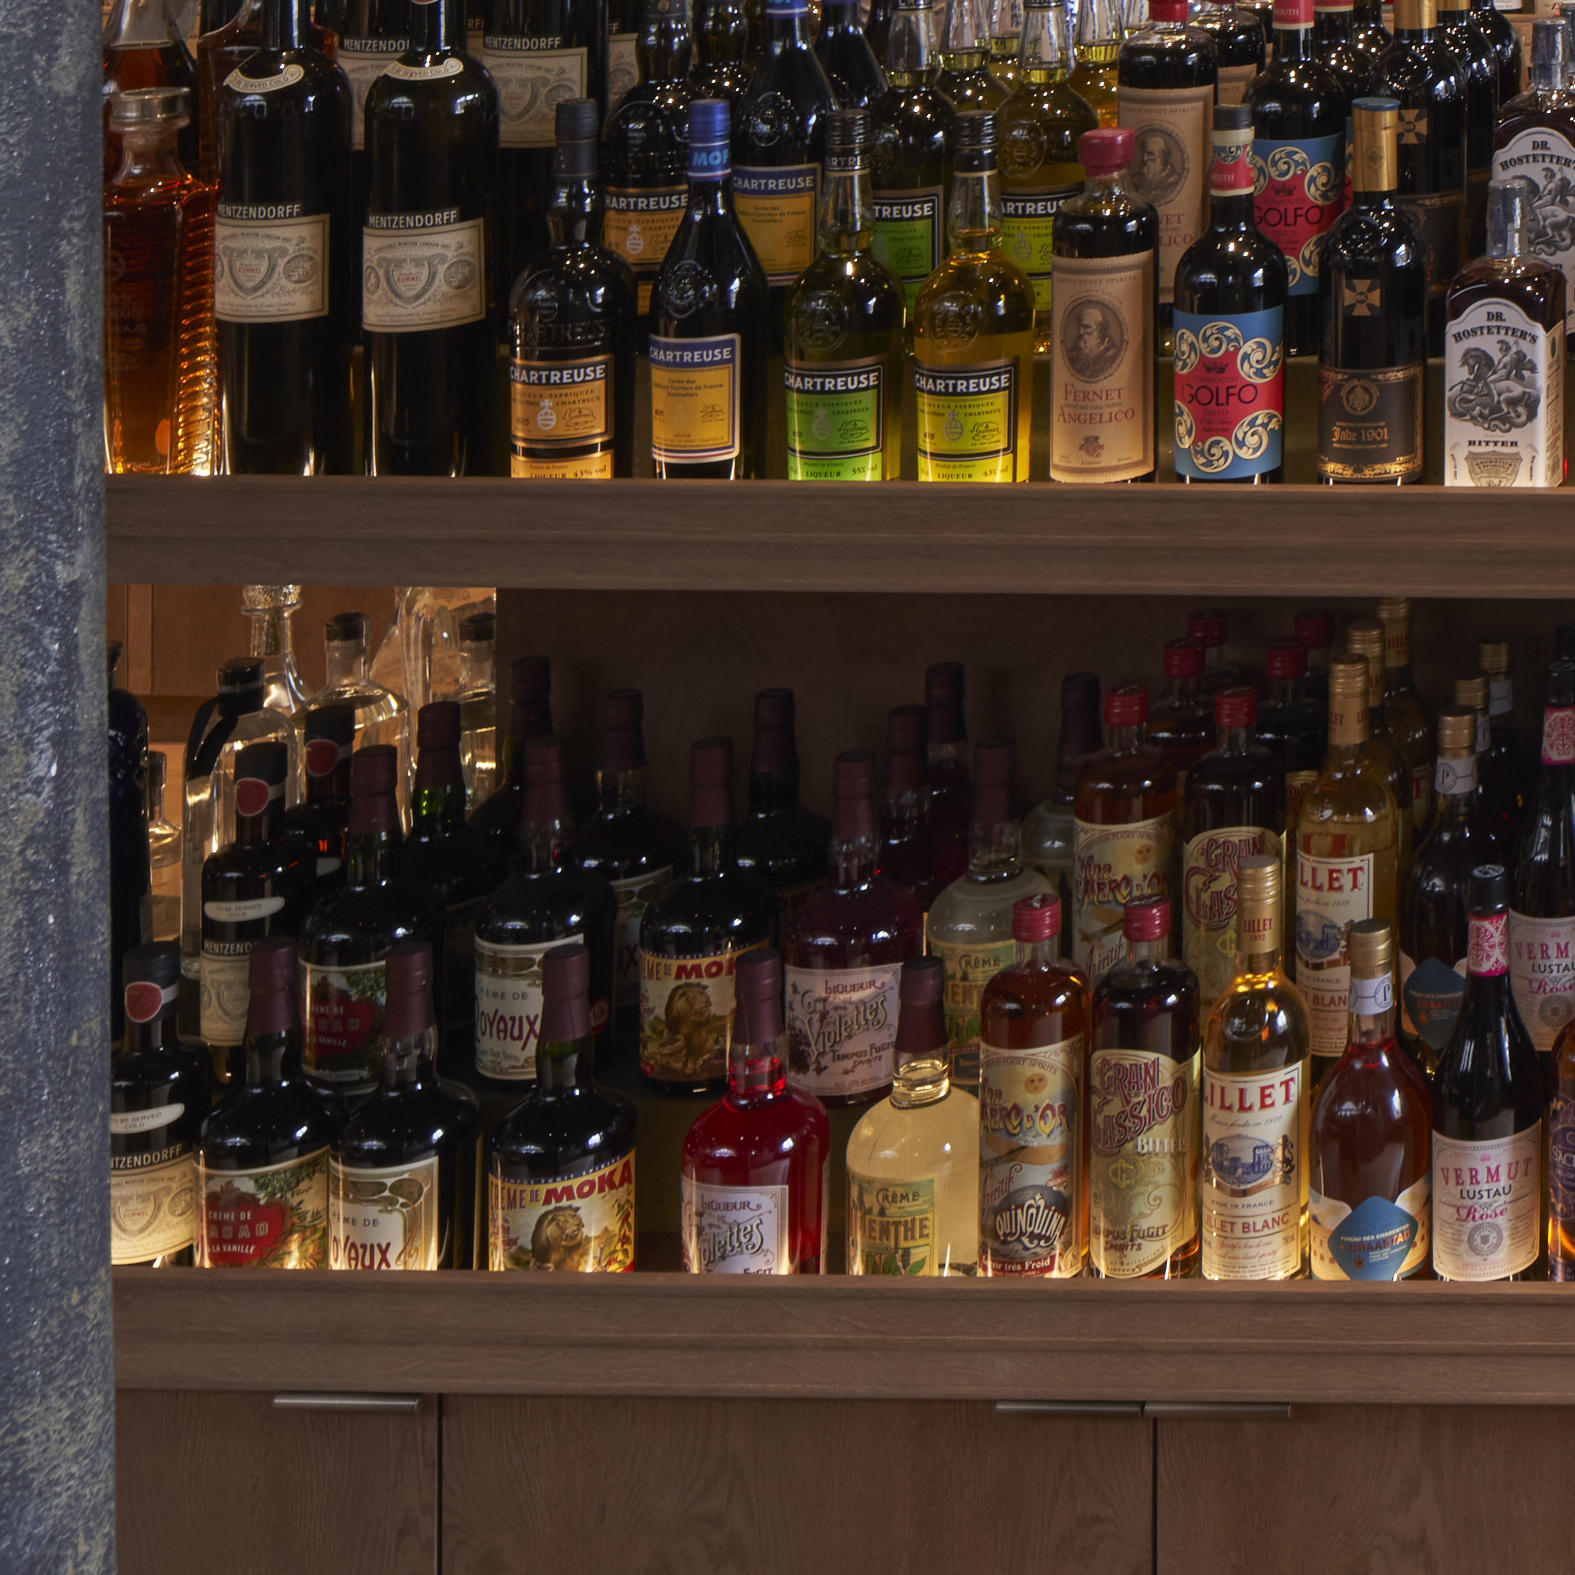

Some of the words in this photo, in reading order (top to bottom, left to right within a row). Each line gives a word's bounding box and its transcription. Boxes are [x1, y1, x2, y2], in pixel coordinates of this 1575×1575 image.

[484, 35, 564, 50] MENTZENDORFF
[1531, 140, 1551, 151] DR.
[732, 173, 815, 192] CHARTREUSE
[369, 210, 457, 228] MENTZENDORFF
[1253, 205, 1325, 231] GOLFO
[1486, 312, 1507, 323] DR.
[1453, 323, 1538, 344] HOSTETTER'S
[650, 346, 733, 363] CHARTREUSE
[510, 364, 606, 384] CHARTREUSE
[785, 371, 879, 391] CHARTREUSE
[914, 372, 1011, 392] CHARTREUSE
[1063, 386, 1125, 403] FERNET
[1182, 381, 1257, 406] GOLFO
[1057, 406, 1135, 423] ANGELICO
[1332, 425, 1356, 442] Jade
[1358, 426, 1388, 442] 1901
[1469, 439, 1519, 448] BITTER
[1242, 918, 1273, 933] LILLET
[824, 979, 886, 996] LIQUEUR
[804, 996, 887, 1060] Violettes
[851, 1055, 883, 1068] SPIRITS
[1098, 1058, 1160, 1105] GRAN
[1440, 1156, 1533, 1186] VERMUT
[529, 1190, 540, 1202] DE
[542, 1160, 633, 1206] MOKA
[1459, 1184, 1513, 1200] LUSTAU
[701, 1194, 761, 1212] LIQUEUR
[1211, 1200, 1232, 1208] MADE
[1244, 1199, 1274, 1207] FRANCE
[238, 1211, 252, 1221] DE
[1241, 1213, 1290, 1234] BLANC
[1129, 1222, 1169, 1241] FUGIT
[1103, 1241, 1143, 1253] SPIRITS
[1351, 1230, 1412, 1252] BRAASTAD
